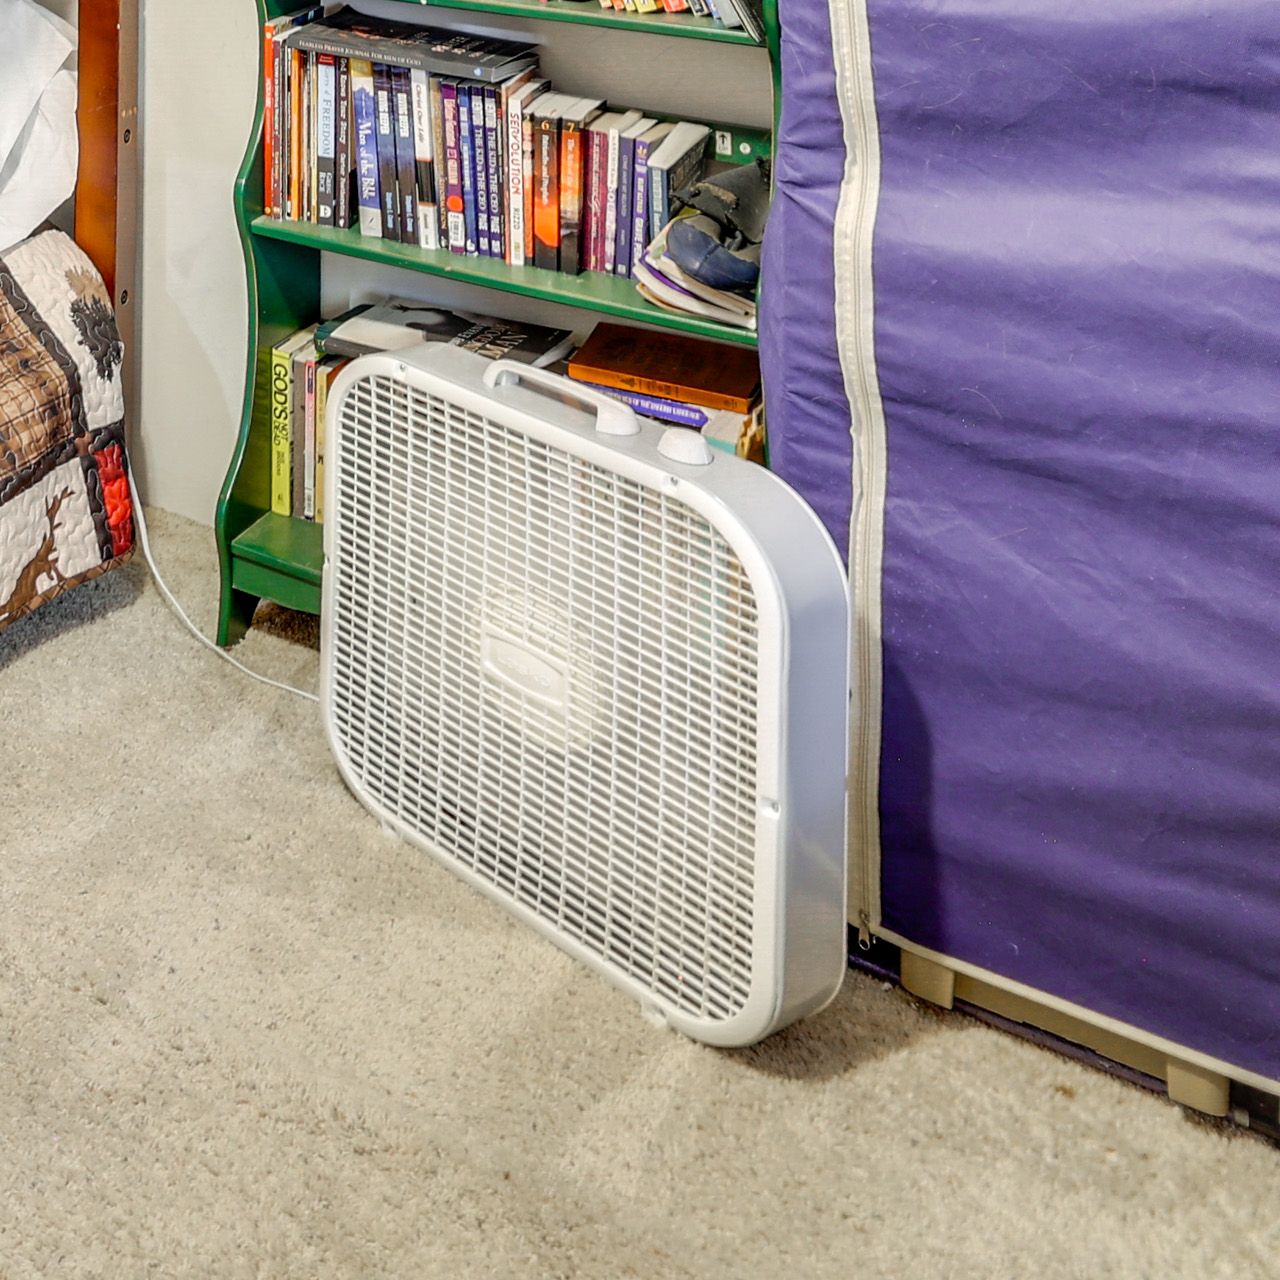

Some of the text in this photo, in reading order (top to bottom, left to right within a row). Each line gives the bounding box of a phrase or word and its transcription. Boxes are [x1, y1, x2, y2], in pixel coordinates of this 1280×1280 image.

[299, 40, 324, 50] FEARLESS
[324, 44, 345, 54] PRAYER
[345, 48, 371, 58] JOURNAL
[371, 52, 384, 60] FOR
[406, 58, 422, 67] GOD
[339, 58, 348, 145] God Knows Your Story
[323, 99, 333, 155] FREEDOM
[417, 110, 425, 126] Our
[541, 120, 550, 130] 6
[567, 123, 575, 132] 7
[474, 128, 484, 148] THE
[487, 131, 496, 150] THE
[567, 139, 575, 151] The
[358, 118, 377, 200] Men of the Bible
[475, 148, 485, 165] KID
[488, 150, 497, 167] KID
[510, 112, 522, 195] SERVOLUTION
[477, 172, 486, 191] THE
[489, 174, 499, 194] THE
[478, 191, 488, 211] CEO
[490, 194, 499, 213] CEO
[513, 208, 521, 230] RIZZO
[273, 363, 289, 421] GOD'S
